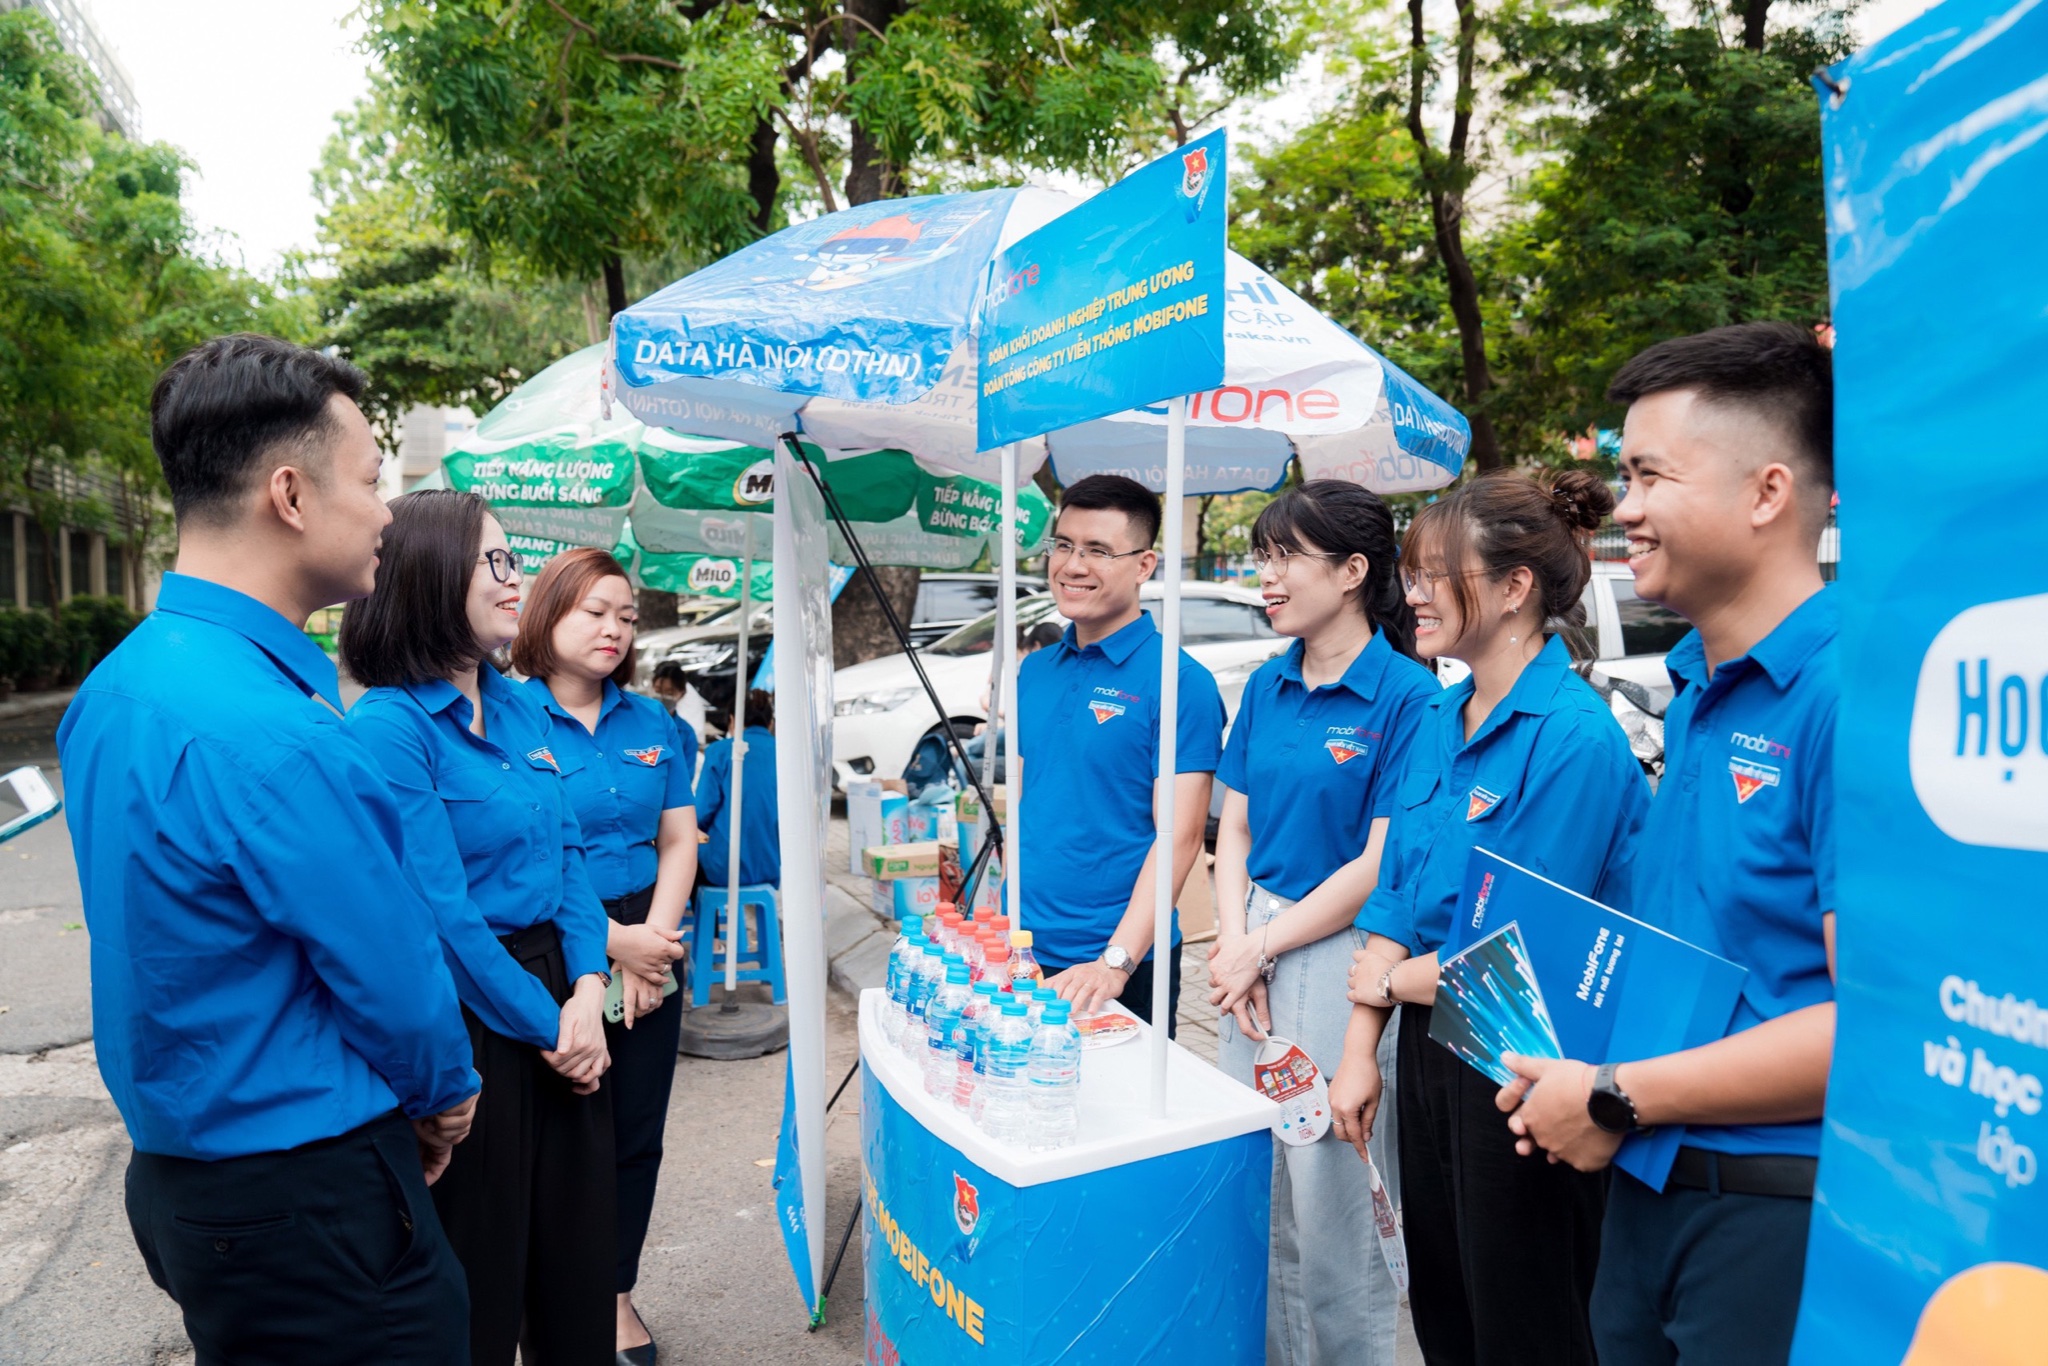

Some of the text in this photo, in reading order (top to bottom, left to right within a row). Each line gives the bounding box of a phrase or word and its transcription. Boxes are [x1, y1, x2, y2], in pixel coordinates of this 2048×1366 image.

[1010, 325, 1031, 355] KHỐI
[1032, 316, 1066, 346] DOANH
[1067, 296, 1106, 330] NGHIỆP
[1107, 279, 1148, 312] TRUNG
[1150, 260, 1194, 293] ƯƠNG
[1226, 276, 1279, 305] HÍ
[1027, 356, 1052, 378] CÔNG
[1052, 348, 1066, 368] TY
[1066, 332, 1091, 363] VIỄN
[1092, 322, 1131, 352] THÔNG
[1133, 294, 1208, 337] MOBIFONE
[635, 337, 921, 382] DATA HÀ NỘI (DTHN)
[556, 459, 615, 480] LƯỢNG
[558, 478, 603, 504] SÁNG
[745, 473, 774, 494] MI
[934, 484, 960, 504] TIẾP
[930, 508, 968, 531] BỪNG
[695, 566, 731, 583] MILO
[1093, 686, 1141, 703] mobifone
[1326, 725, 1383, 742] mobifone
[1955, 658, 2048, 783] Họ
[1471, 872, 1492, 929] mobifone
[1576, 927, 1610, 1001] MobiFone
[1938, 974, 2048, 1050] Chươn
[1923, 1035, 2044, 1119] và học
[1976, 1120, 2038, 1189] lớp
[878, 1199, 985, 1347] MOBIFONE
